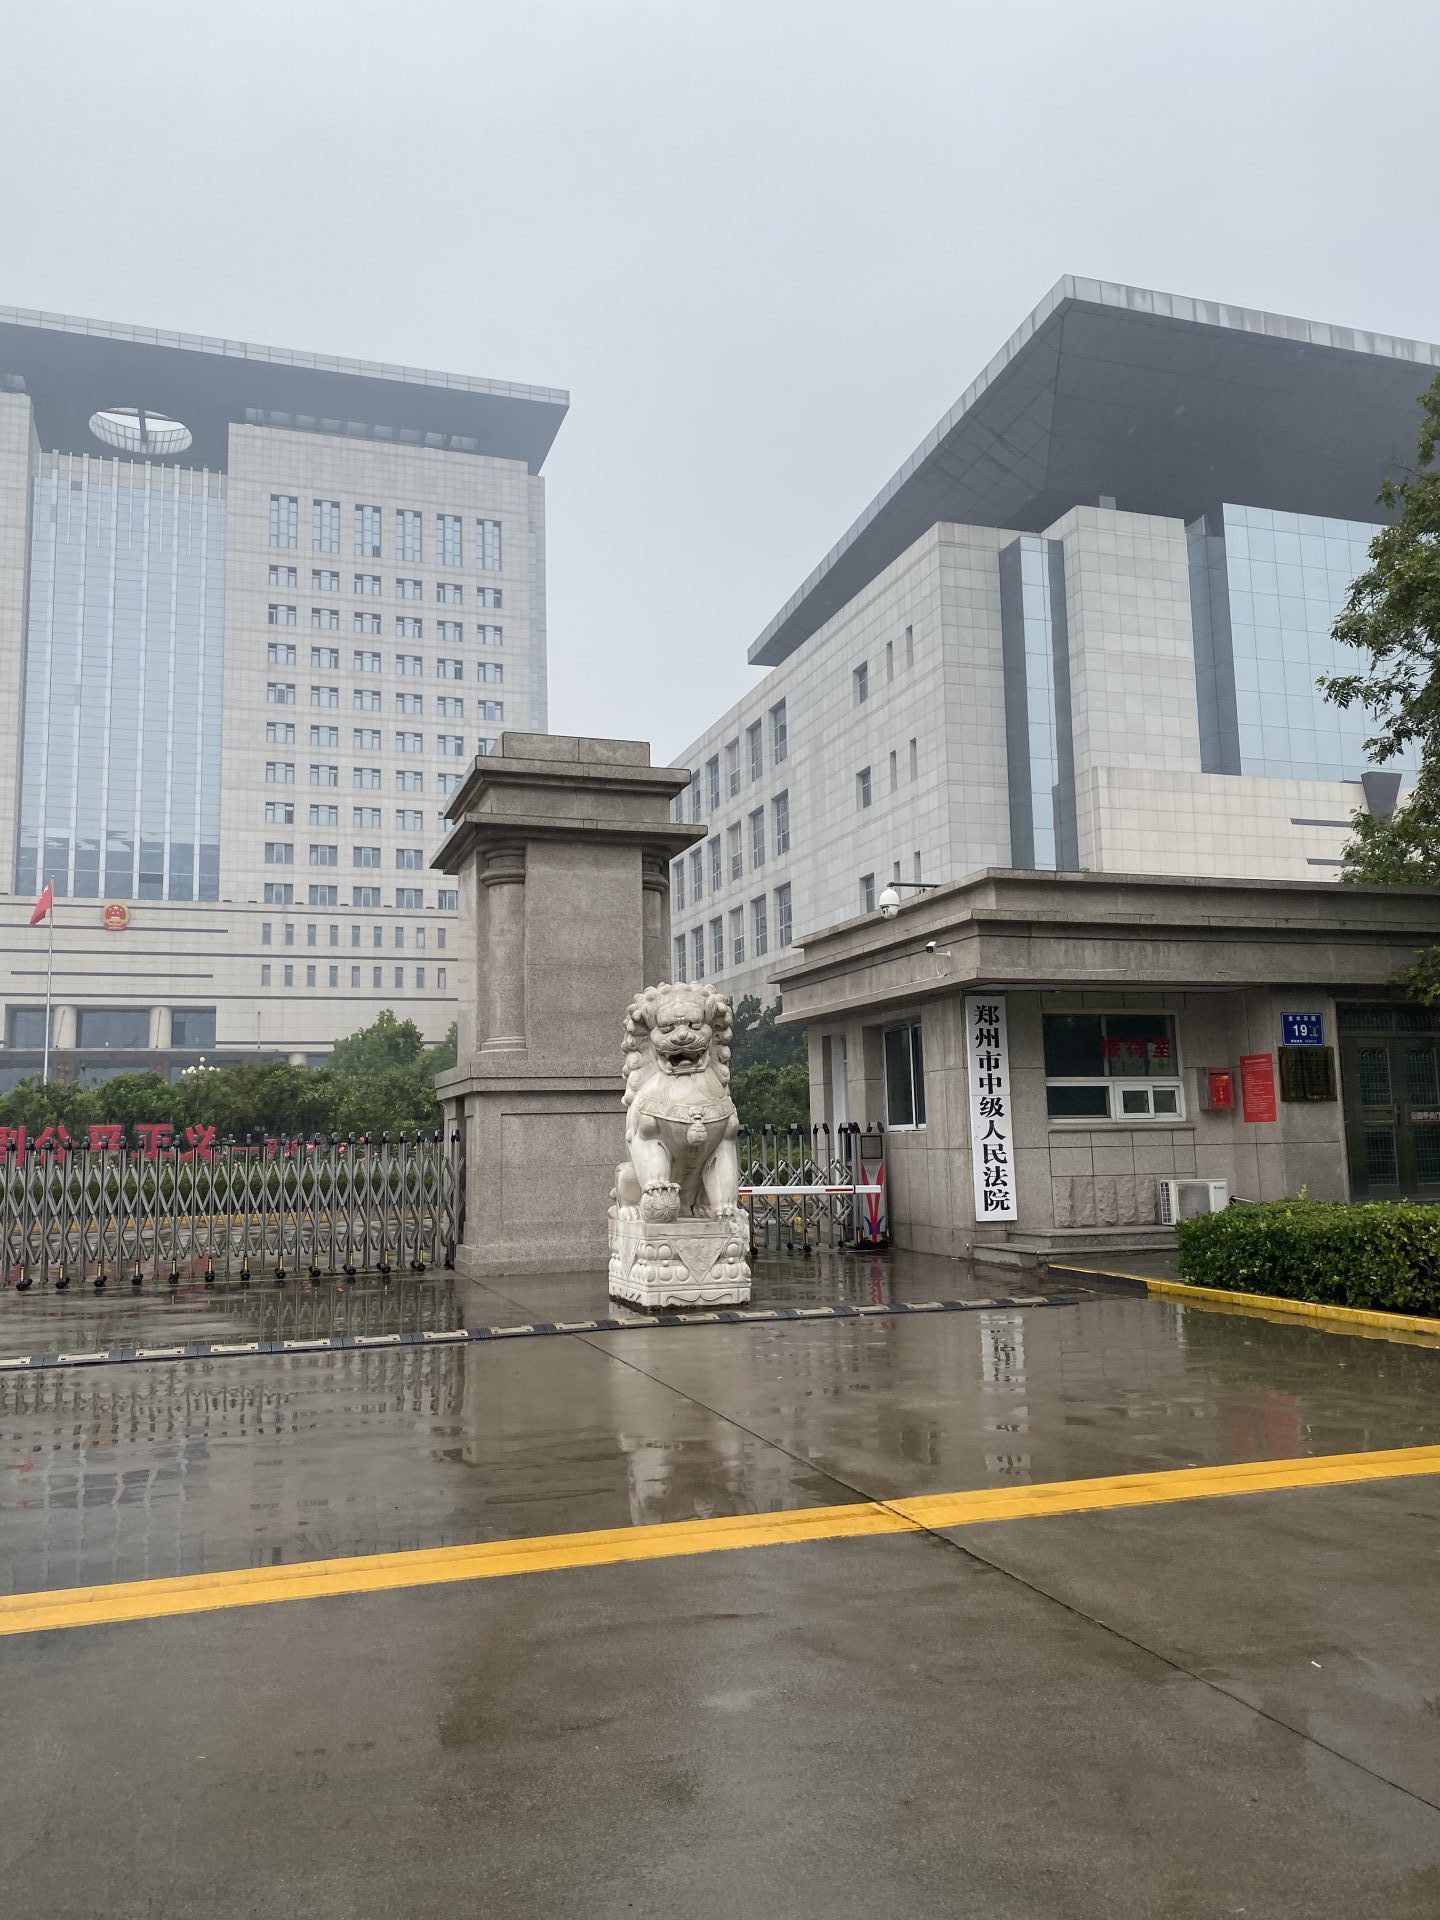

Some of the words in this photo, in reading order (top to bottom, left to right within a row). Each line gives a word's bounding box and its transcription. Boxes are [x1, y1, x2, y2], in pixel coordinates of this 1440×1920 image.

[973, 1004, 1011, 1212] 郑州市中级人民法院
